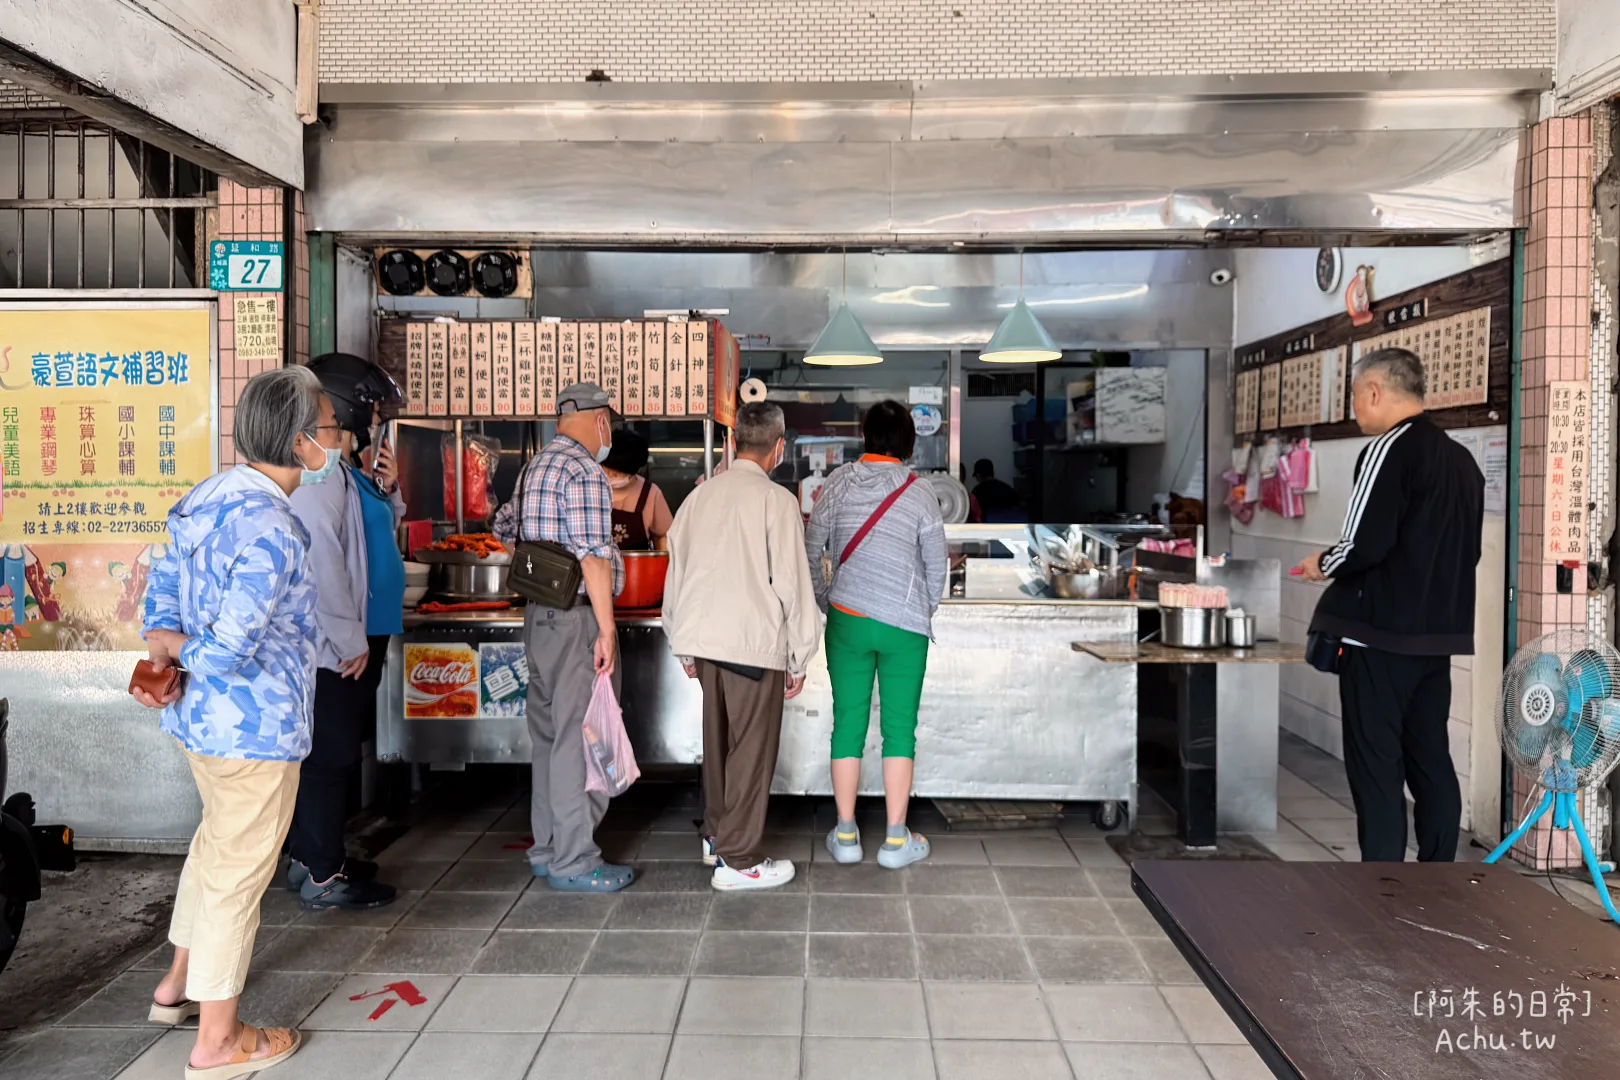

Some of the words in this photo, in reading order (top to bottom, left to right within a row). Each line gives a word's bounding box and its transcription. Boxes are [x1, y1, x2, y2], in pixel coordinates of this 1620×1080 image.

[241, 259, 271, 284] 27
[237, 300, 276, 313] 急售一樓
[31, 350, 190, 387] 豪萱語文補習班
[497, 331, 509, 398] 梅干扣肉便當
[519, 332, 532, 398] 三杯雞便當
[584, 332, 596, 383] 家傳冬瓜肉
[648, 332, 660, 398] 竹筍湯
[670, 332, 682, 399] 金針湯
[692, 333, 704, 397] 四神湯
[410, 403, 423, 411] 100
[431, 403, 444, 412] 100
[476, 403, 488, 411] 95
[497, 403, 510, 411] 90
[519, 403, 532, 411] 95
[540, 403, 554, 411] 90
[627, 403, 639, 412] 90
[648, 403, 660, 411] 35
[670, 403, 682, 412] 35
[692, 402, 704, 411] 50
[1552, 415, 1569, 427] 10:30
[2, 406, 20, 476] 兒童美語
[40, 406, 57, 476] 專業鋼琴
[79, 406, 96, 476] 珠算心算
[119, 405, 135, 476] 國小課輔
[159, 405, 176, 476] 國中課輔
[1550, 441, 1568, 454] 20:30
[1567, 389, 1587, 553] 本店皆採用台灣溫體肉品
[38, 501, 147, 516] 請上2樓歡迎參觀
[410, 661, 475, 684] Coca-Cola
